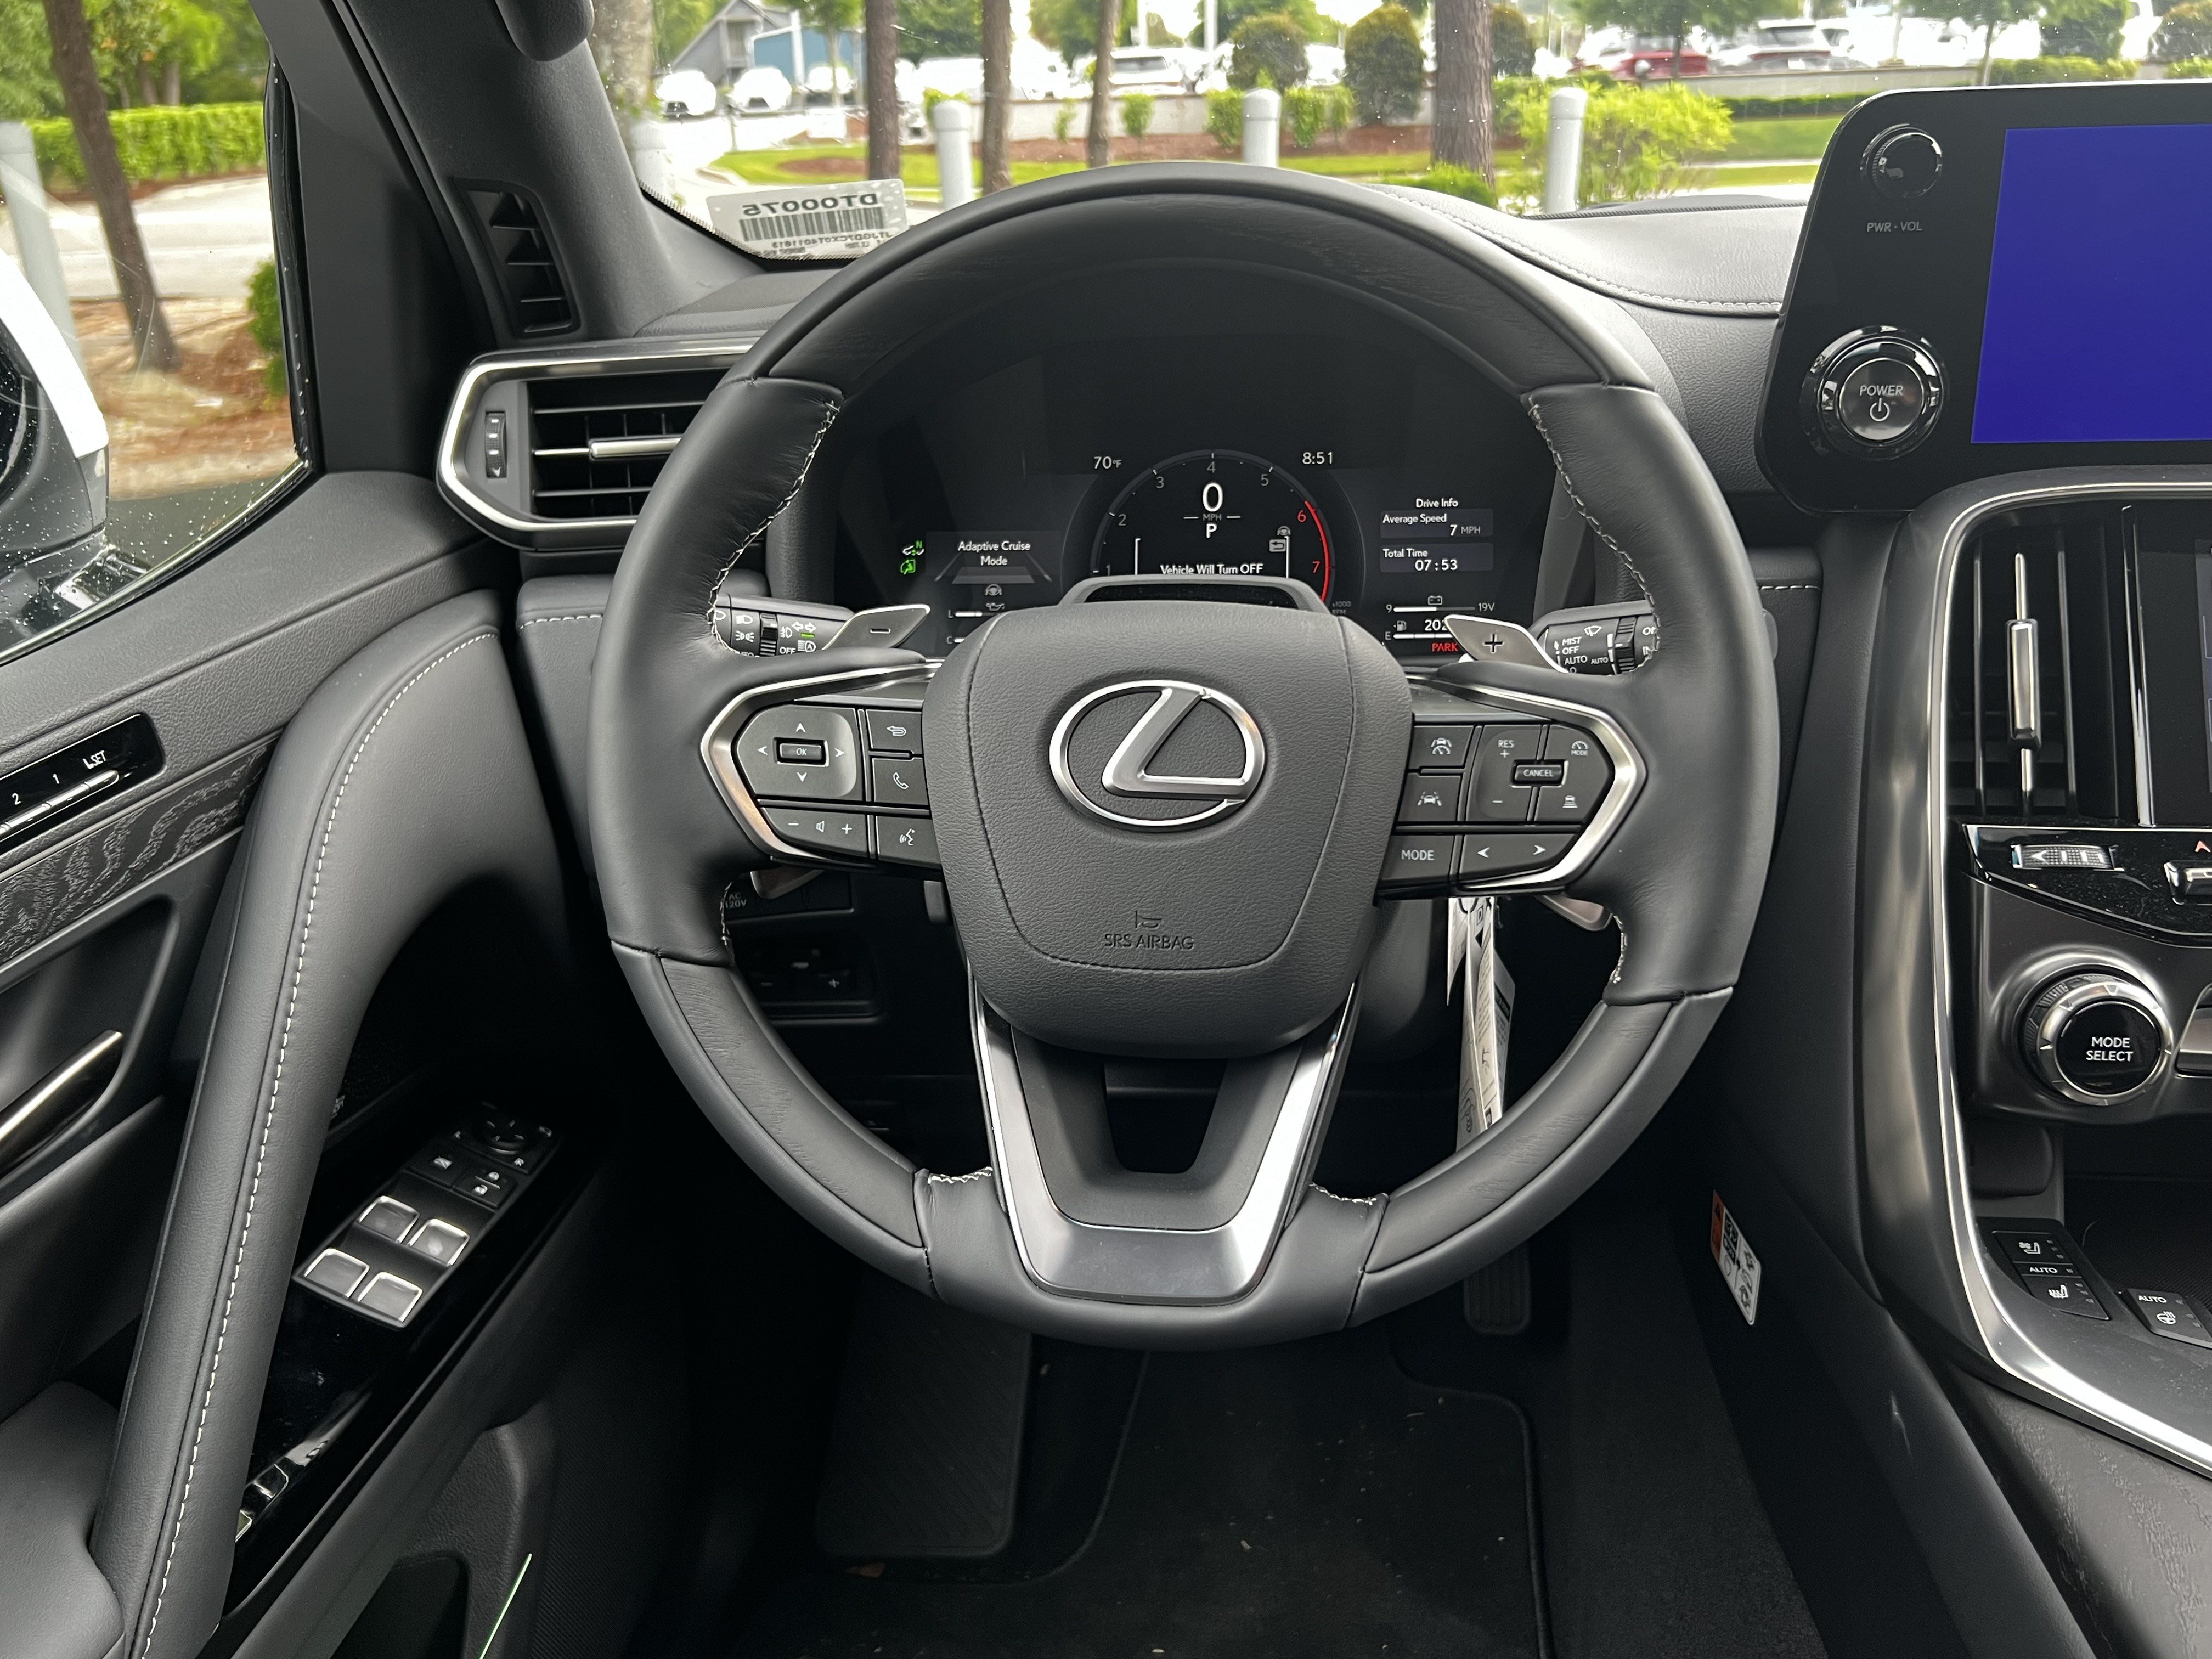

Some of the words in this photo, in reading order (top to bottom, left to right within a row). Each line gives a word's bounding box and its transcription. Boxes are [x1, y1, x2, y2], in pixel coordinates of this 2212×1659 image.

[1866, 222, 1892, 233] PWR
[1900, 221, 1922, 232] VOL
[1859, 385, 1904, 396] POWER
[1302, 452, 1333, 465] 8:51
[1207, 462, 1216, 473] 4
[1156, 477, 1164, 488] 3
[1261, 475, 1269, 486] 5
[1202, 483, 1223, 512] 0
[1415, 499, 1438, 508] Drive
[1441, 498, 1458, 508] Info
[1119, 515, 1126, 526] 2
[1297, 510, 1306, 522] 6
[1383, 515, 1418, 524] Average
[1420, 514, 1447, 524] Speed
[1206, 524, 1217, 538] P
[1450, 525, 1457, 535] 7
[1461, 526, 1481, 535] MPH
[958, 541, 999, 552] Adaptive
[1001, 541, 1031, 551] Cruise
[1383, 549, 1404, 558] Total
[1406, 549, 1428, 558] Time
[980, 556, 1007, 566] Mode
[1160, 565, 1194, 575] Vehicle
[1196, 564, 1215, 574] Will
[1217, 564, 1238, 574] Turn
[1240, 563, 1263, 574] OFF
[1312, 561, 1321, 574] 7
[1386, 604, 1392, 613] 9
[1478, 602, 1495, 612] 19V
[948, 610, 953, 618] L
[946, 636, 953, 645] C
[1385, 631, 1391, 641] E
[1562, 636, 1582, 646] MIST
[1562, 646, 1579, 655] OFF
[1565, 656, 1587, 665] AUTO
[1498, 740, 1514, 748] RES
[796, 748, 808, 756] OK
[53, 773, 60, 784] 1
[1523, 769, 1554, 777] CANCEL
[12, 793, 21, 805] 2
[1401, 850, 1434, 861] MODE
[1104, 933, 1132, 947] SRS
[1136, 934, 1195, 950] AIRBAG
[2091, 1036, 2130, 1048] MODE
[2086, 1051, 2133, 1062] SELECT
[2138, 1295, 2166, 1304] AUTO
